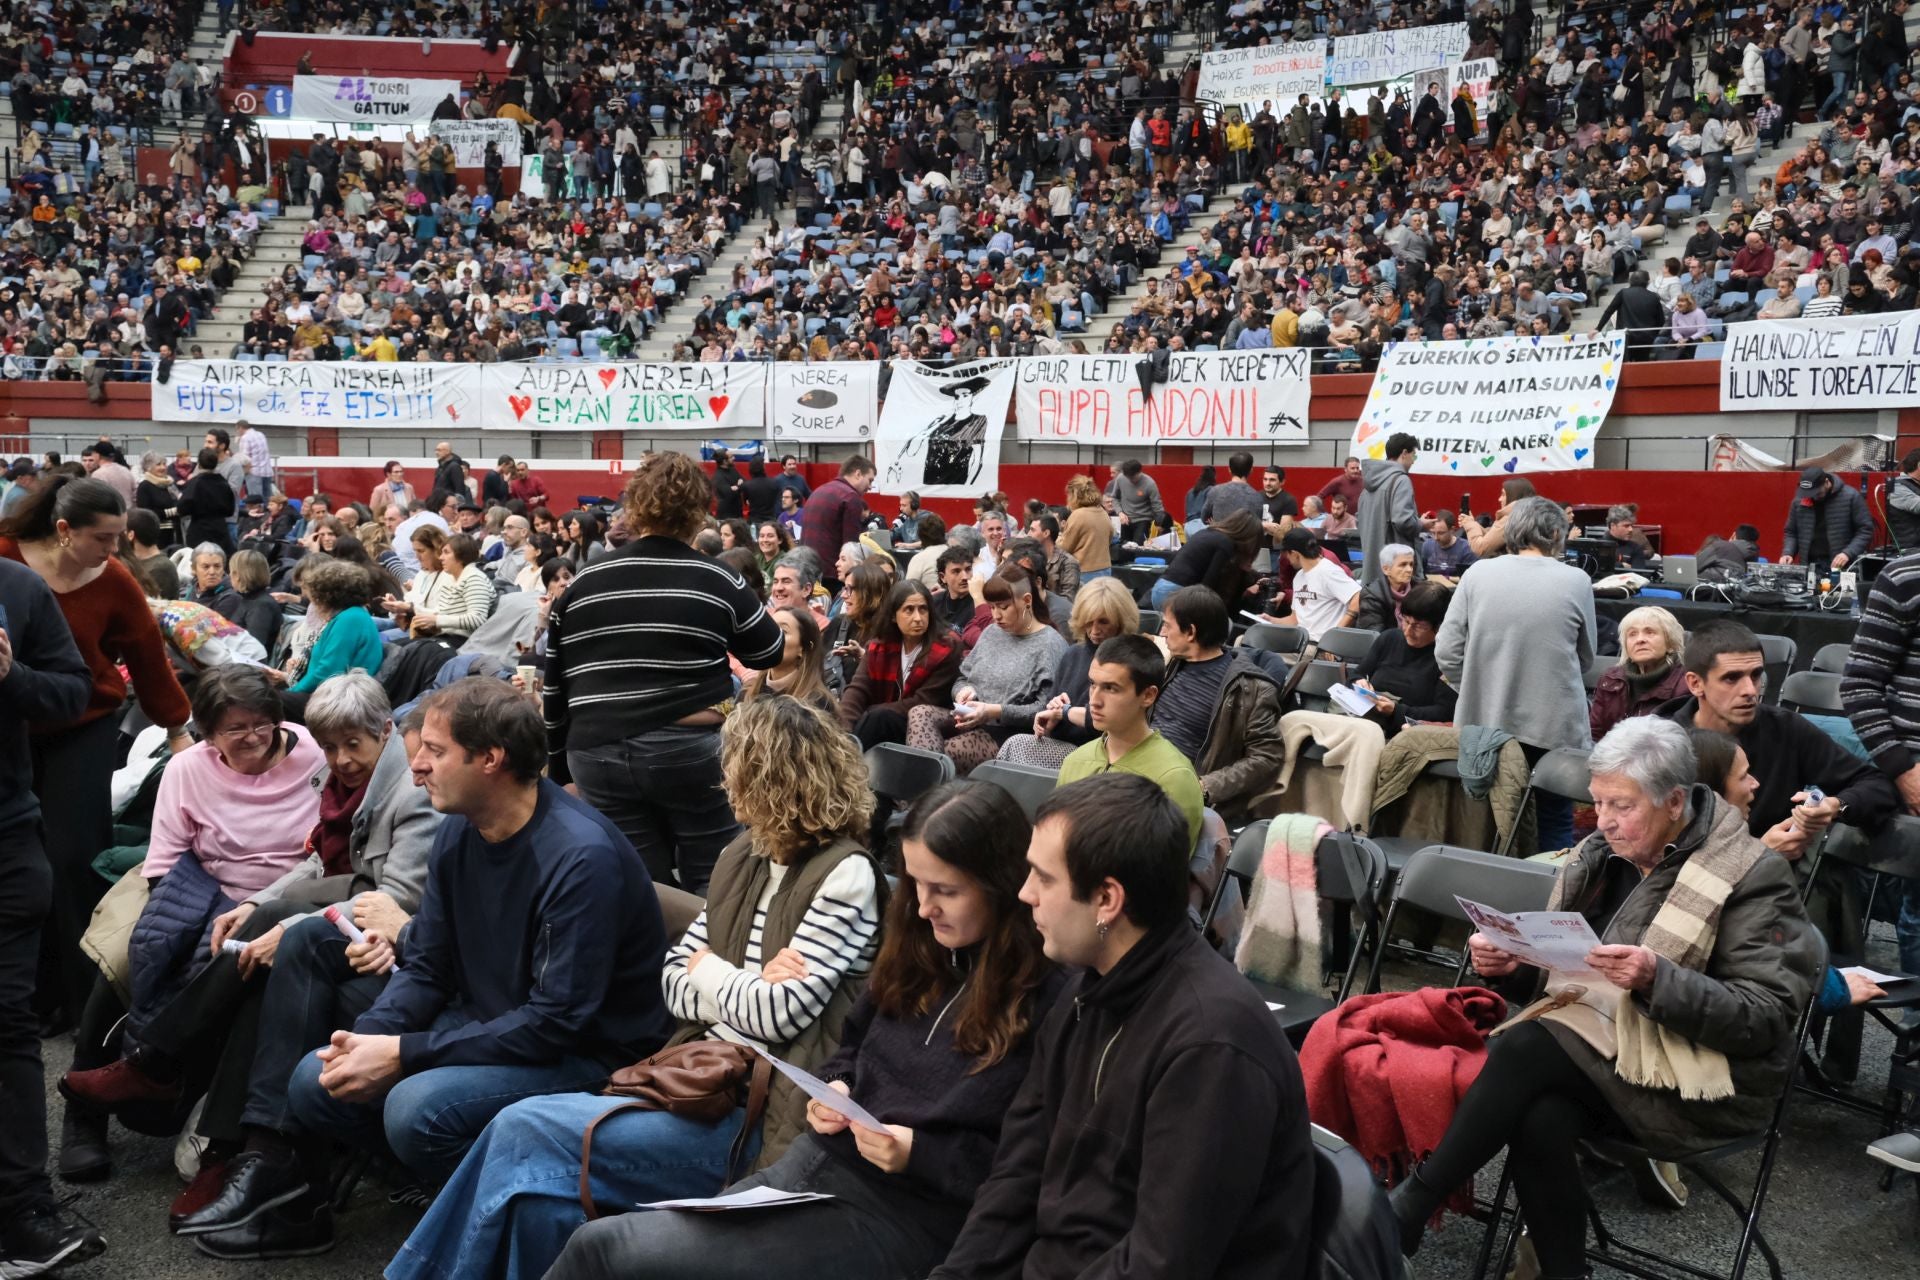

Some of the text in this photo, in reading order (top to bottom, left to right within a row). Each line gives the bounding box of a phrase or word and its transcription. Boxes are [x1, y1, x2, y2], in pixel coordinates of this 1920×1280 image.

[1457, 62, 1489, 81] AUPA
[369, 82, 409, 95] TORRI
[1201, 88, 1226, 99] EMAN
[354, 101, 410, 115] GATTUN
[1396, 340, 1615, 366] ZUREKIKO SENTITZEN
[203, 364, 313, 388] AURRERA
[334, 368, 406, 390] NEREA
[515, 365, 728, 395] AUPA NEREA!
[791, 370, 848, 388] NEREA
[1024, 359, 1068, 384] GAUR
[1389, 374, 1602, 396] DUGUN MAITASUNA
[537, 394, 705, 424] EMAN ZUREA
[1039, 387, 1257, 439] AUPA ANDONI!
[1409, 410, 1432, 423] EZ
[1437, 410, 1462, 423] DA
[792, 413, 845, 429] ZUREA
